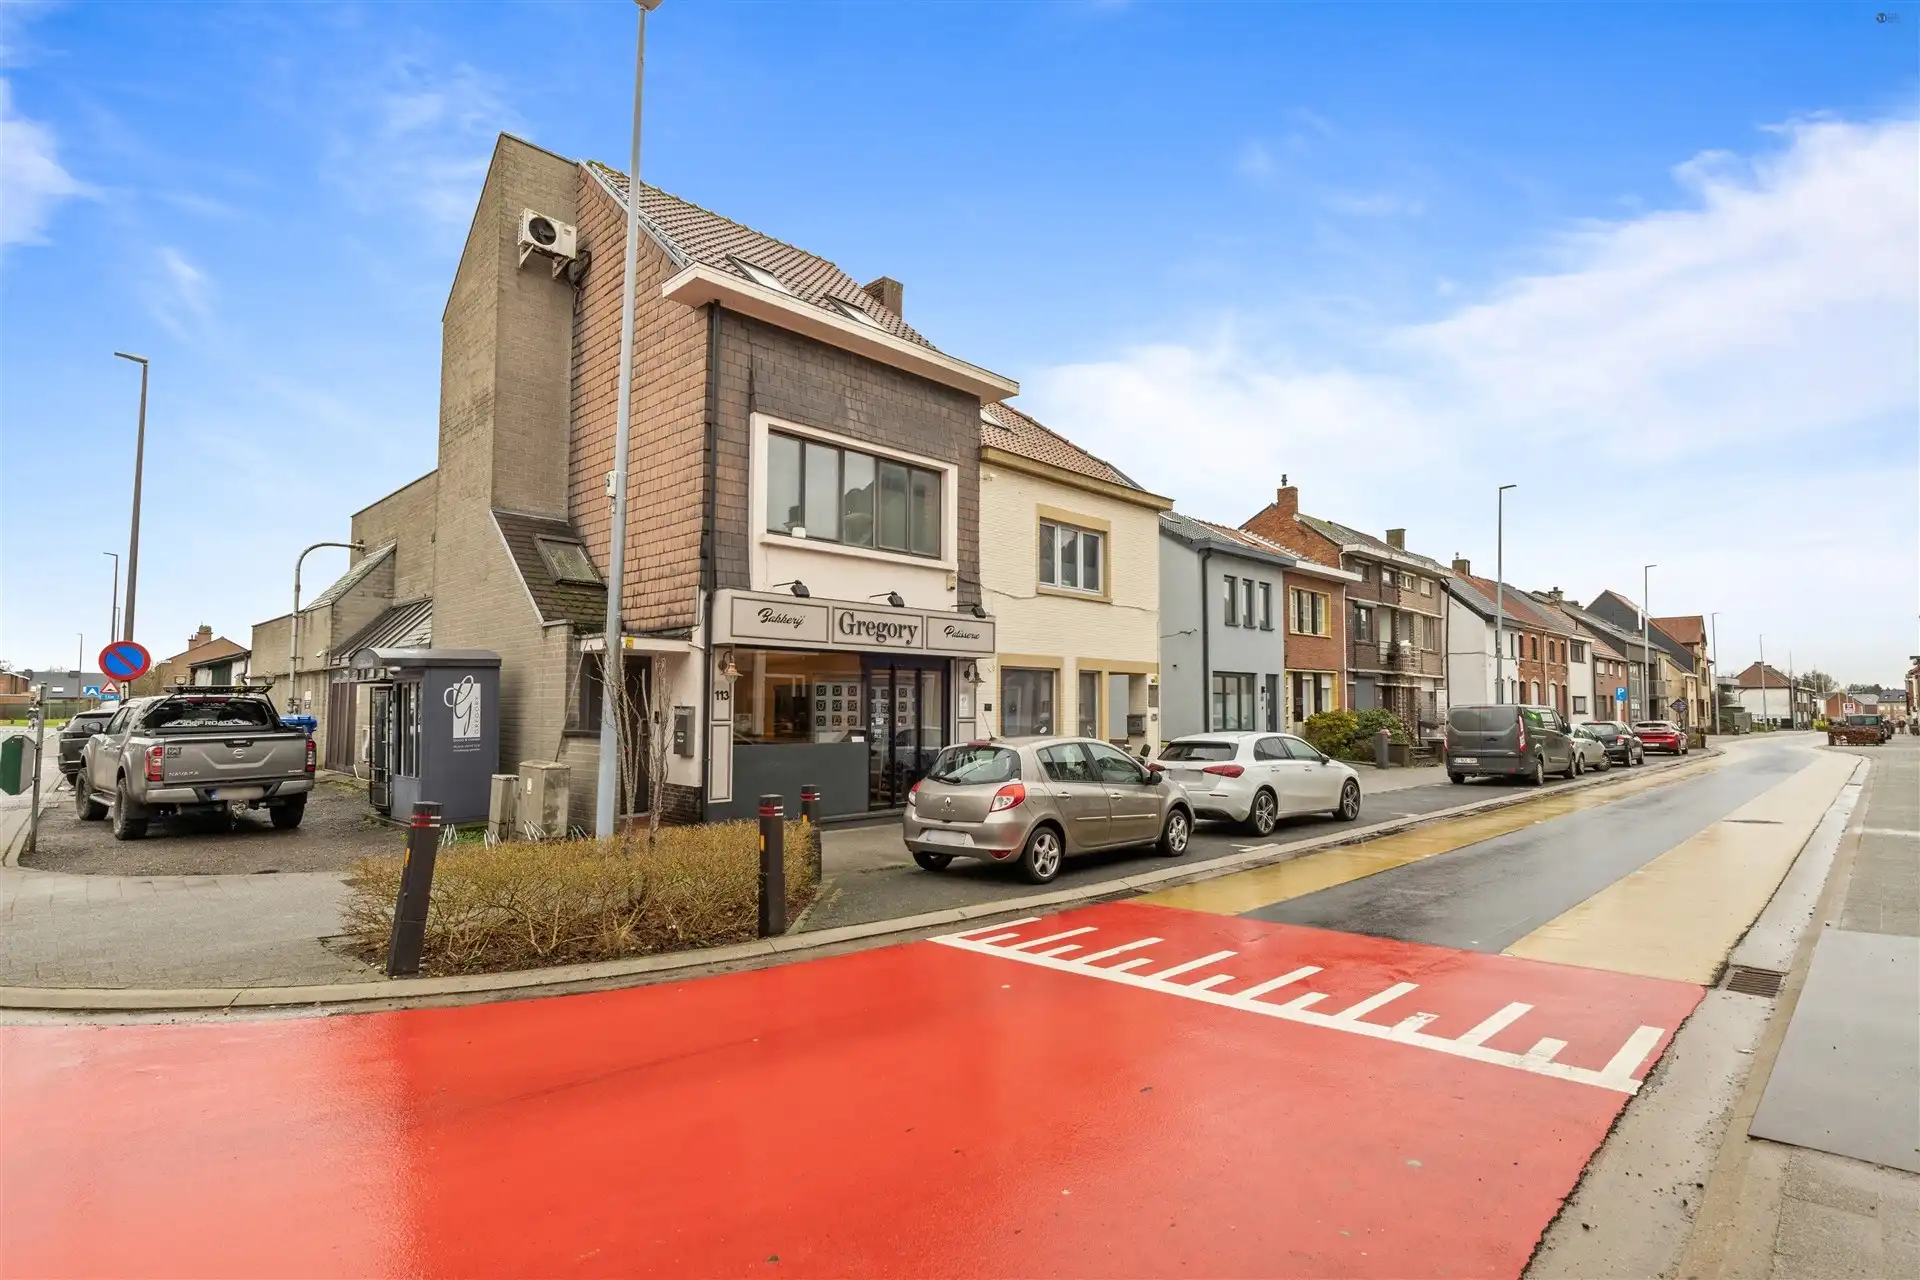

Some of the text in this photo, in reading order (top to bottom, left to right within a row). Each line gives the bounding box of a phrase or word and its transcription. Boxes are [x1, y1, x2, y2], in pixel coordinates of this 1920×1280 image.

[757, 607, 805, 629] Bakkerij
[839, 611, 919, 645] Gregory
[943, 624, 980, 640] Patisserie
[715, 690, 729, 701] 113
[1617, 687, 1624, 695] P
